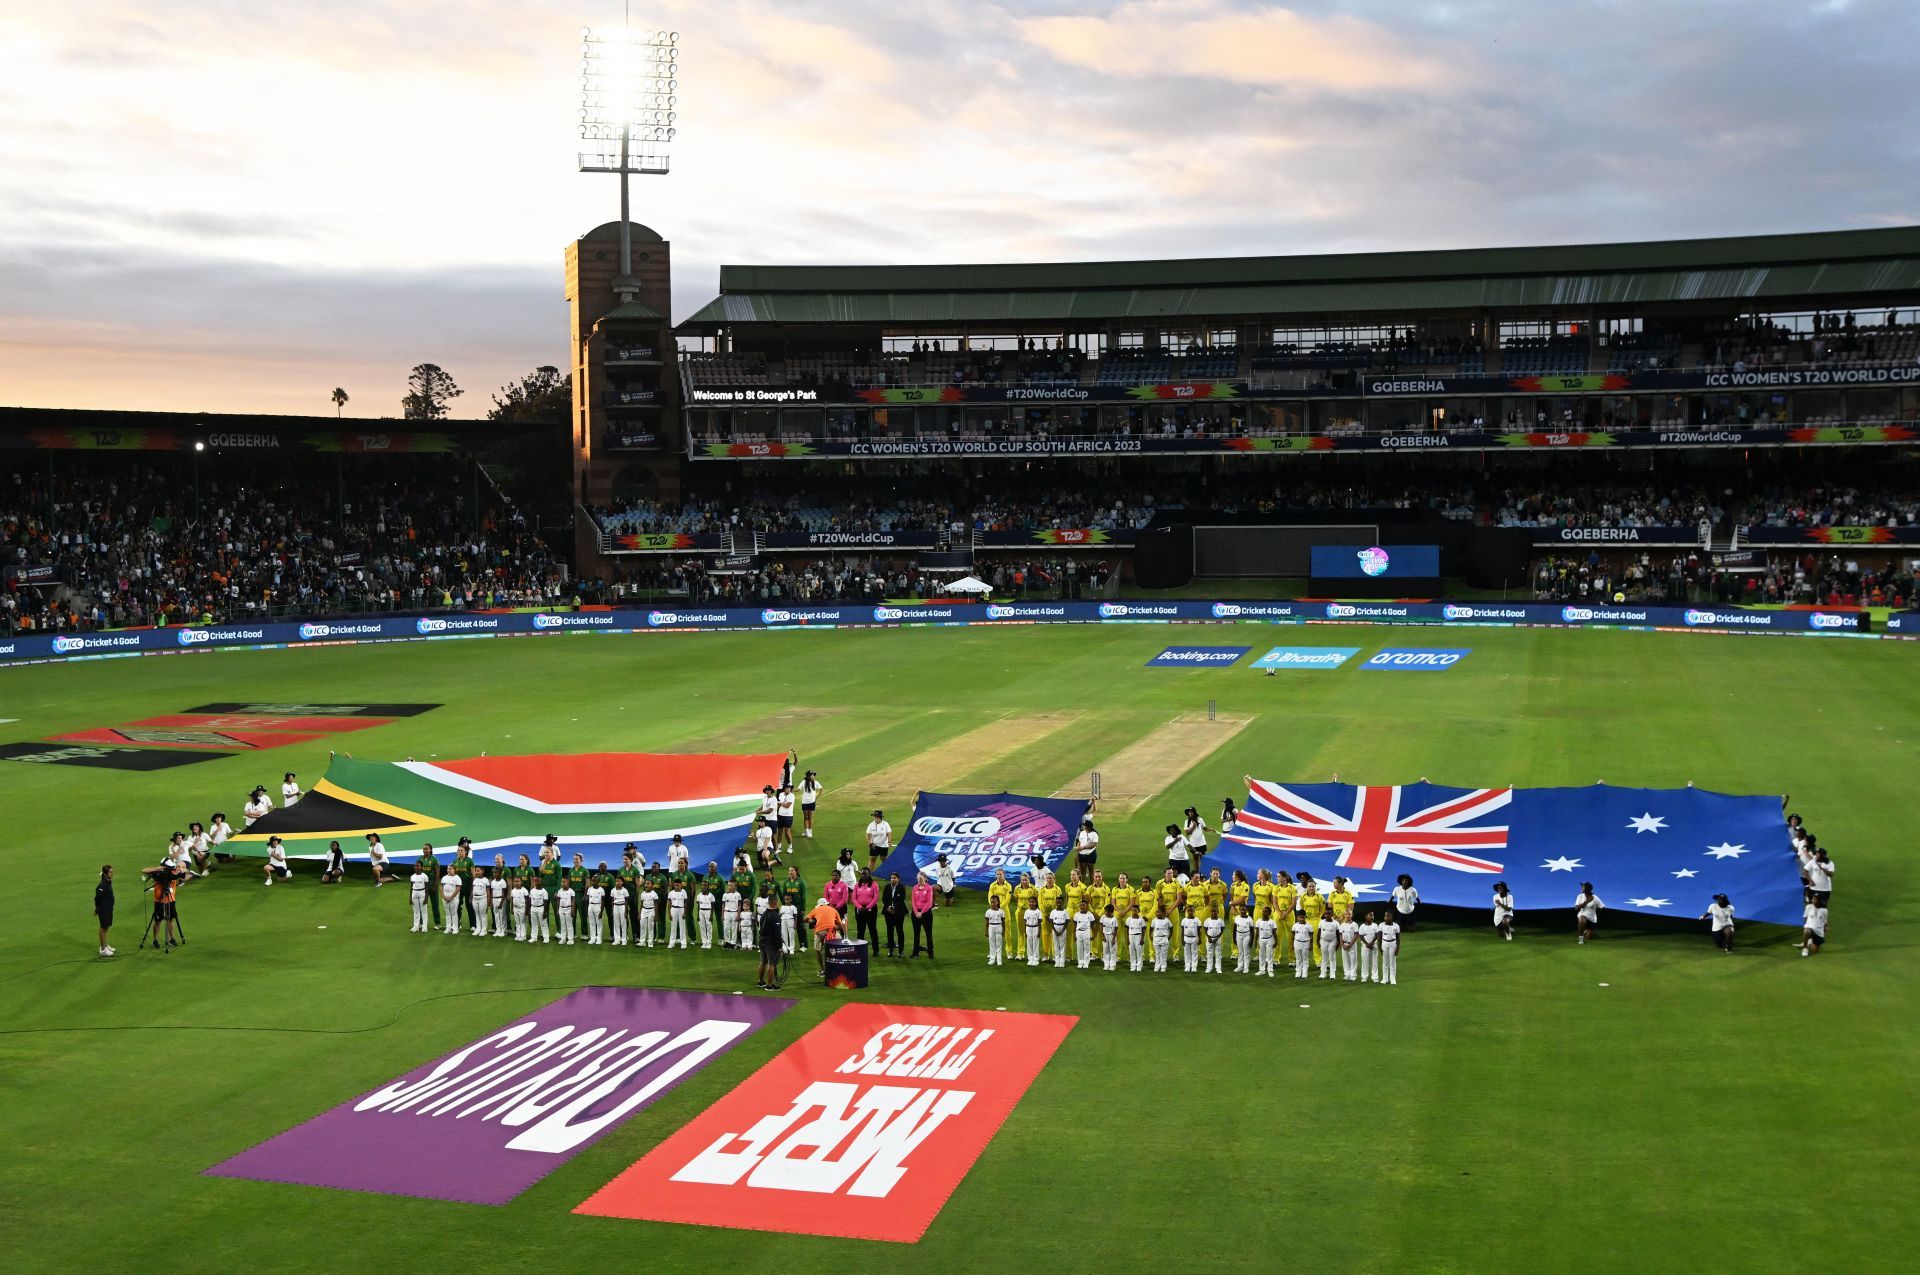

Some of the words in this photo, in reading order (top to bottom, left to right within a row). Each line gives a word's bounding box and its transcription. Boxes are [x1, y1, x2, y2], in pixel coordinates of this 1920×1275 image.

[1705, 374, 1729, 386] ICC
[1731, 372, 1802, 385] WOMEN'S
[1804, 371, 1830, 383] T20
[1831, 369, 1888, 382] WORLD
[1889, 368, 1920, 381] CUP
[1172, 386, 1195, 397] T20
[1372, 380, 1445, 392] GQEBERHA
[693, 390, 734, 400] Welcome
[734, 391, 744, 400] to
[745, 390, 755, 400] St
[757, 390, 795, 402] George's
[796, 389, 817, 400] Park
[1006, 388, 1089, 400] #T20WorldCup
[208, 432, 280, 448] GQEBERHA
[1380, 436, 1449, 447] GQEBERHA
[1545, 433, 1569, 445] T20
[1660, 432, 1742, 443] #T20WorldCup
[850, 443, 869, 454] ICC
[871, 443, 929, 453] WOMEN'S
[930, 443, 951, 453] T20
[952, 442, 997, 453] WORLD
[999, 442, 1024, 452] CUP
[1025, 441, 1066, 452] SOUTH
[1068, 441, 1112, 451] AFRICA
[1114, 440, 1142, 451] 2023
[1270, 439, 1293, 448] T20
[748, 444, 771, 455] T20
[809, 532, 894, 545] #T20WorldCup
[1060, 530, 1083, 541] T20
[1561, 528, 1639, 540] GQEBERHA
[1838, 528, 1864, 540] T20
[646, 536, 668, 546] T20
[775, 612, 789, 620] ICC
[791, 612, 815, 620] Cricket
[887, 610, 901, 618] ICC
[903, 610, 927, 618] Cricket
[999, 608, 1013, 616] ICC
[1016, 608, 1040, 616] Cricket
[1112, 607, 1126, 615] ICC
[1128, 607, 1153, 615] Cricket
[1225, 606, 1239, 614] ICC
[1242, 607, 1266, 615] Cricket
[1340, 607, 1354, 615] ICC
[1357, 608, 1381, 616] Cricket
[1457, 609, 1471, 617] ICC
[1474, 609, 1499, 617] Cricket
[1576, 610, 1591, 619] ICC
[1594, 611, 1619, 619] Cricket
[546, 617, 561, 625] ICC
[564, 617, 588, 625] Cricket
[661, 615, 675, 623] ICC
[678, 615, 702, 623] Cricket
[1700, 614, 1714, 623] ICC
[1717, 615, 1743, 623] Cricket
[1826, 616, 1840, 626] ICC
[1843, 617, 1858, 626] Cric
[313, 626, 327, 635] ICC
[331, 626, 356, 634] Cricket
[431, 621, 445, 629] ICC
[447, 621, 472, 629] Cricket
[193, 632, 207, 641] ICC
[210, 632, 236, 640] Cricket
[0, 644, 14, 653] ood
[67, 638, 82, 648] ICC
[85, 638, 111, 647] Cricket
[1157, 651, 1239, 662] Booking.com
[1277, 652, 1347, 663] BharatPe
[1370, 653, 1460, 664] aramco
[944, 820, 989, 834] ICC
[933, 837, 1047, 855] Cricket
[835, 1022, 996, 1081] TYRES
[353, 1021, 671, 1126] BYJU'S
[669, 1080, 976, 1198] MRF
